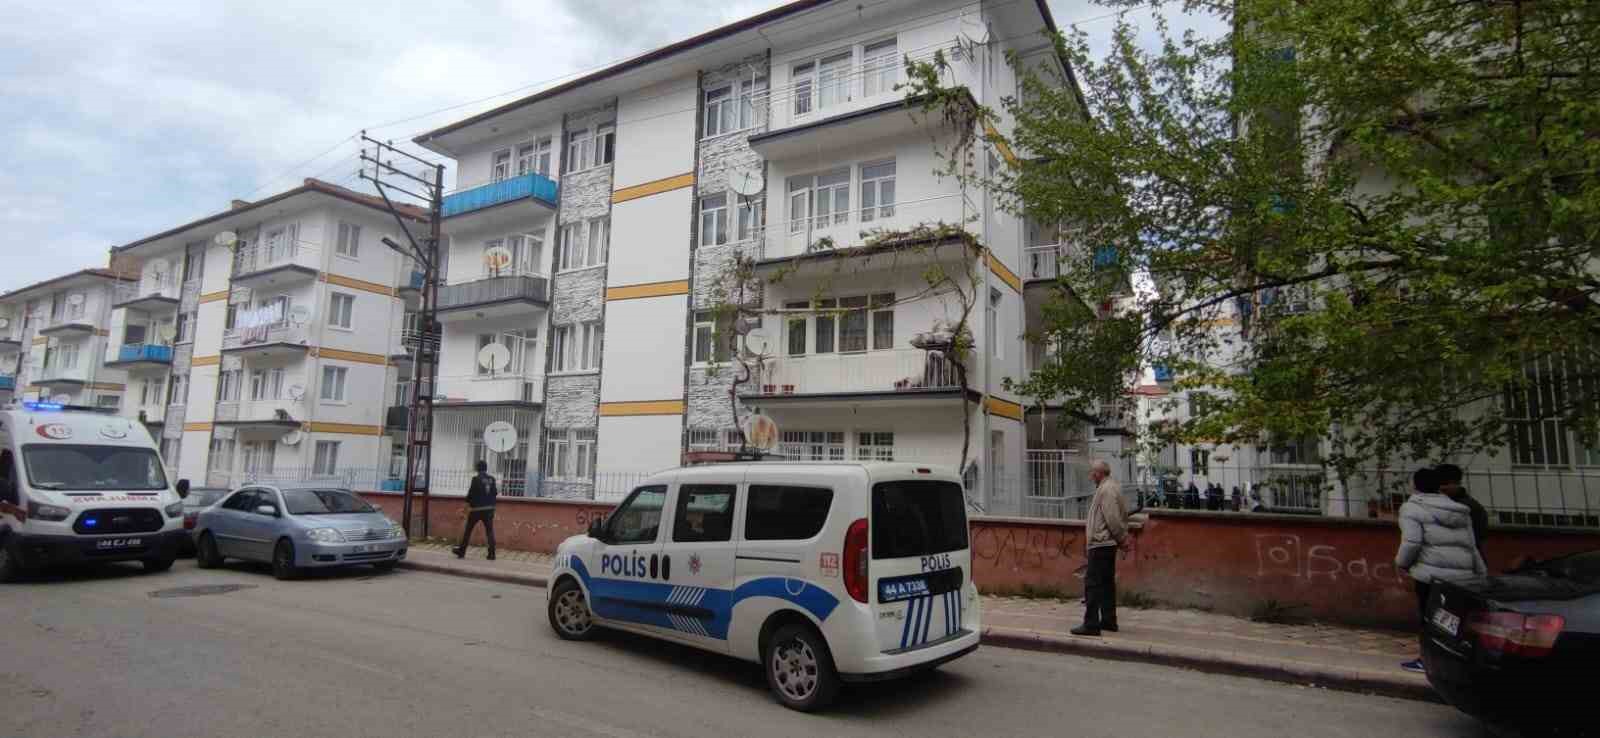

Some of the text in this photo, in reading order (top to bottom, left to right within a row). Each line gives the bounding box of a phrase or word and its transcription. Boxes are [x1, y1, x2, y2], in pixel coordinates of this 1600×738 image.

[602, 549, 646, 578] POLİS
[885, 584, 897, 595] 44
[898, 583, 906, 593] A
